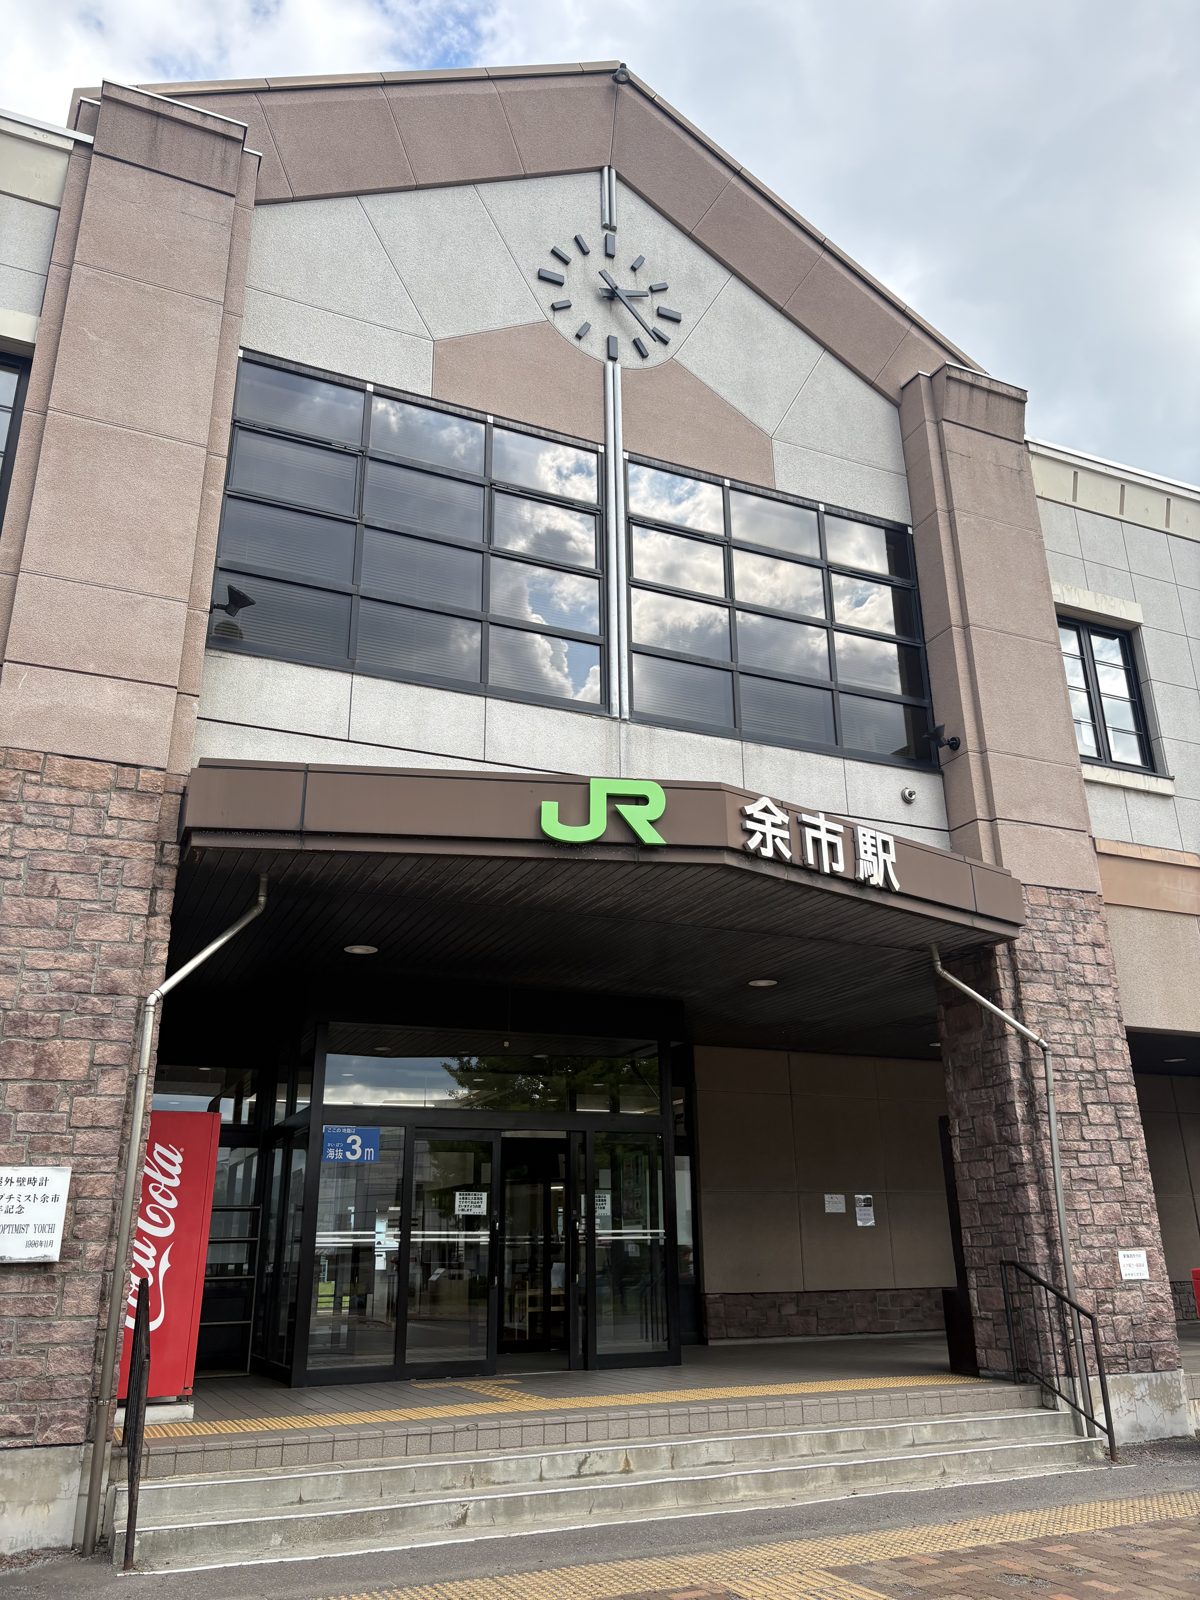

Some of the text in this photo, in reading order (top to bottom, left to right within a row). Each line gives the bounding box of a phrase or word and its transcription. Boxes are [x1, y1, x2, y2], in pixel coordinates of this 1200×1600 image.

[540, 777, 667, 845] JR
[742, 796, 900, 892] 余市駅
[326, 1147, 344, 1160] 海抜
[33, 1223, 56, 1234] YOICHI
